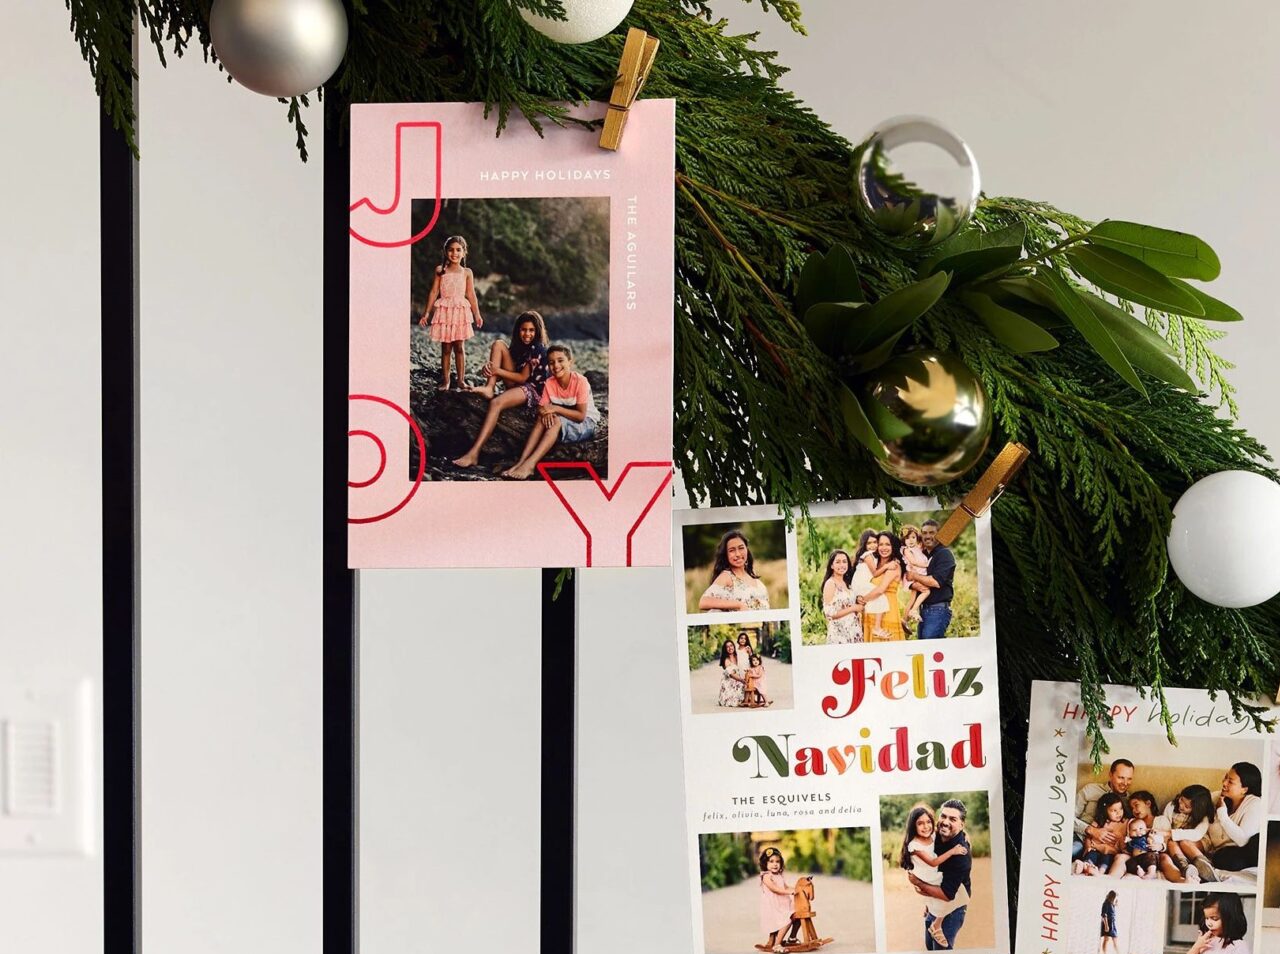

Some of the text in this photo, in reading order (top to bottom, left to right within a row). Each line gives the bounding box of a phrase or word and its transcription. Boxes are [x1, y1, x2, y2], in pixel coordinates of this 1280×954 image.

[480, 169, 611, 181] HAPPY HOLIDAYS
[626, 195, 637, 311] THE AGUILARS
[821, 650, 984, 719] Feliz
[731, 722, 987, 779] Navidad
[732, 792, 832, 806] THE ESQUIVELS
[793, 808, 815, 816] rosa
[818, 806, 836, 815] and
[838, 805, 862, 814] delia
[1041, 874, 1062, 942] HAPPY
